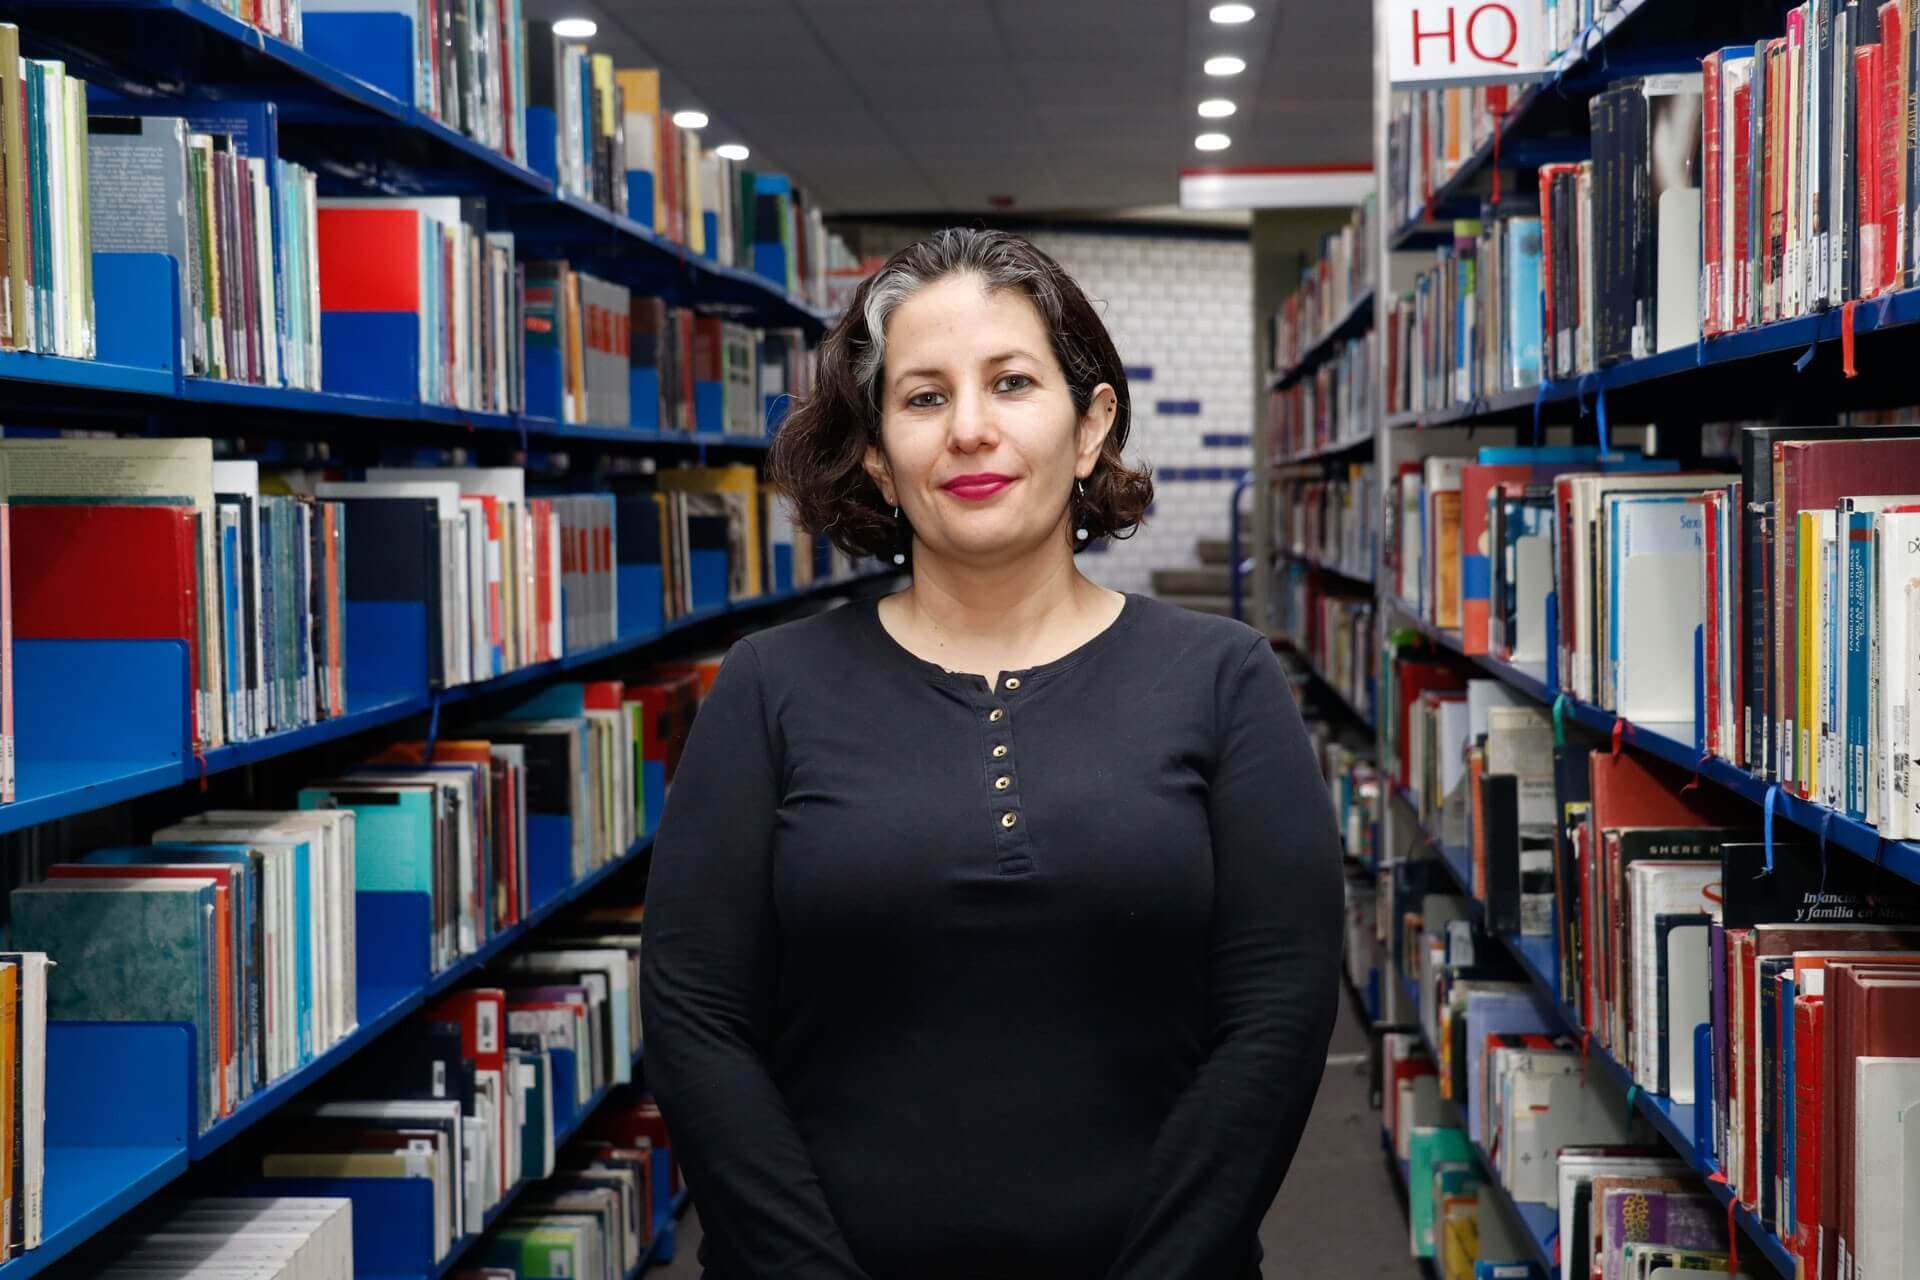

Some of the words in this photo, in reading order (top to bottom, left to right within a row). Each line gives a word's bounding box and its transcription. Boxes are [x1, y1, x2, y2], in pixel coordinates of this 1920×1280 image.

[1412, 3, 1518, 67] HQ
[1648, 845, 1701, 855] SHERE
[1794, 908, 1805, 922] y
[1806, 903, 1854, 921] familia
